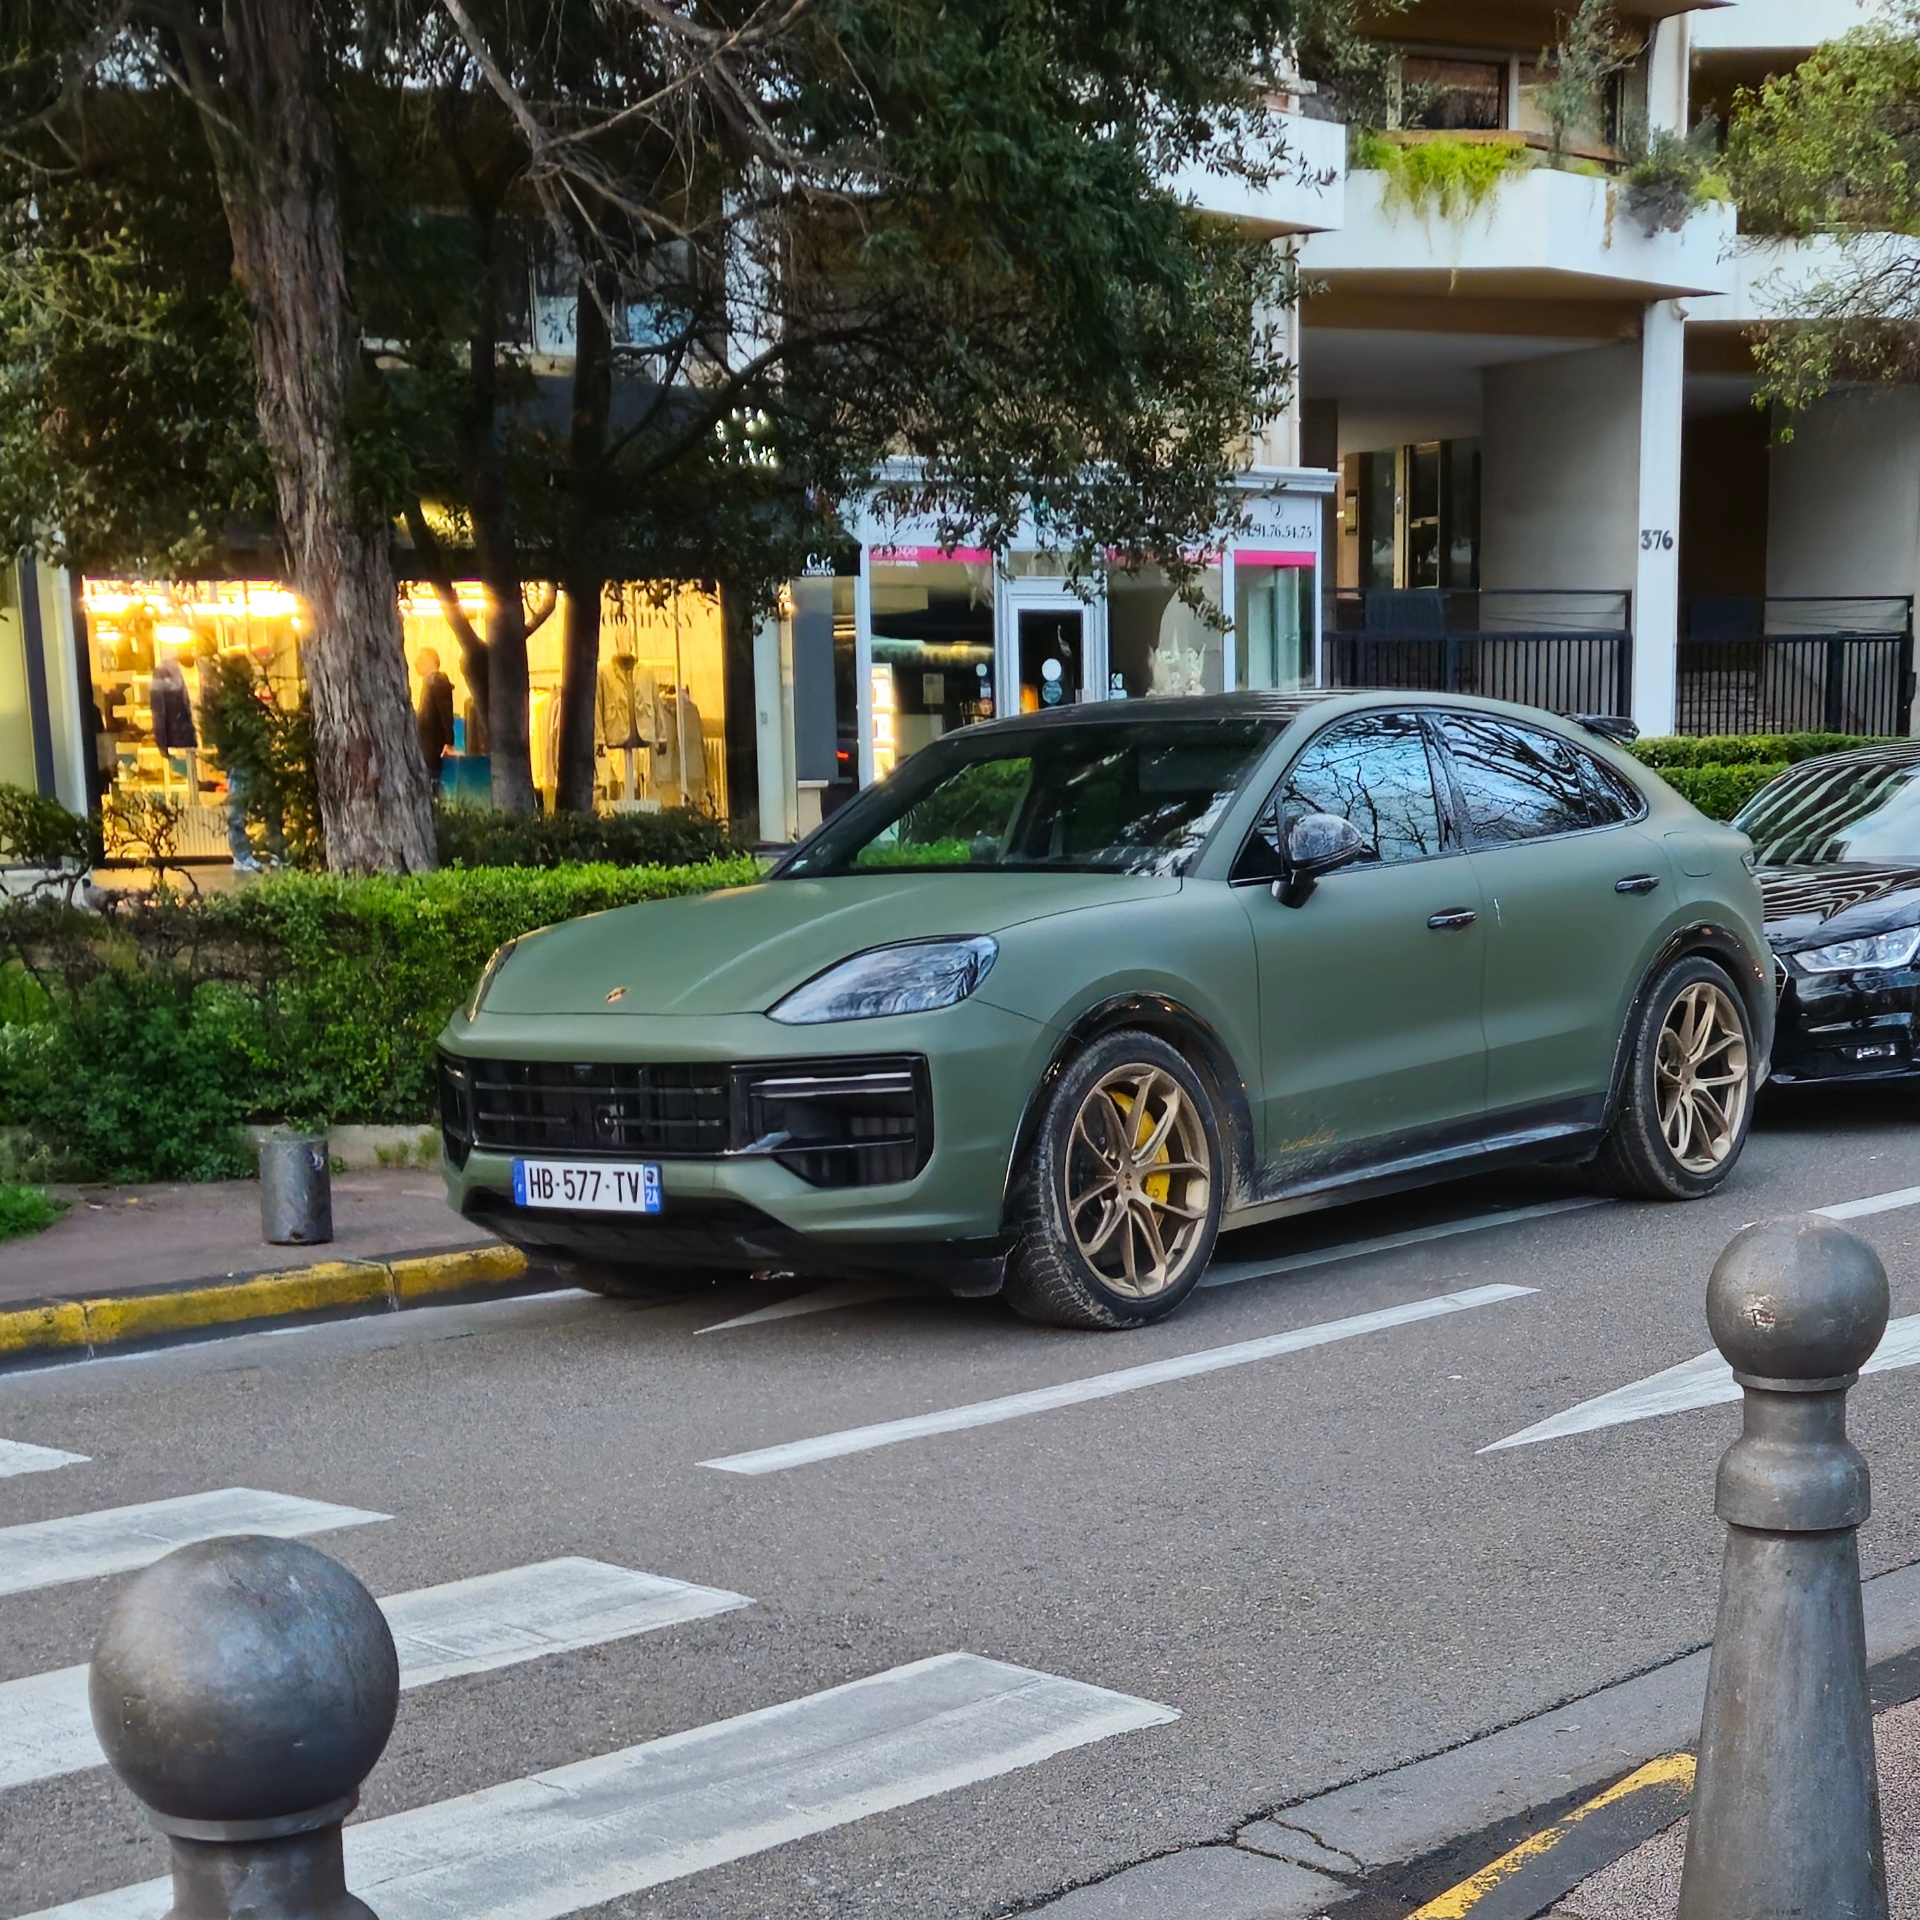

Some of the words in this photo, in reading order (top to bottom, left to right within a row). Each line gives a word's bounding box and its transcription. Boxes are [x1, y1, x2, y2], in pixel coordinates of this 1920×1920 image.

[1640, 529, 1674, 551] 376
[529, 1167, 639, 1204] HB-577-TV
[646, 1189, 659, 1205] 2A
